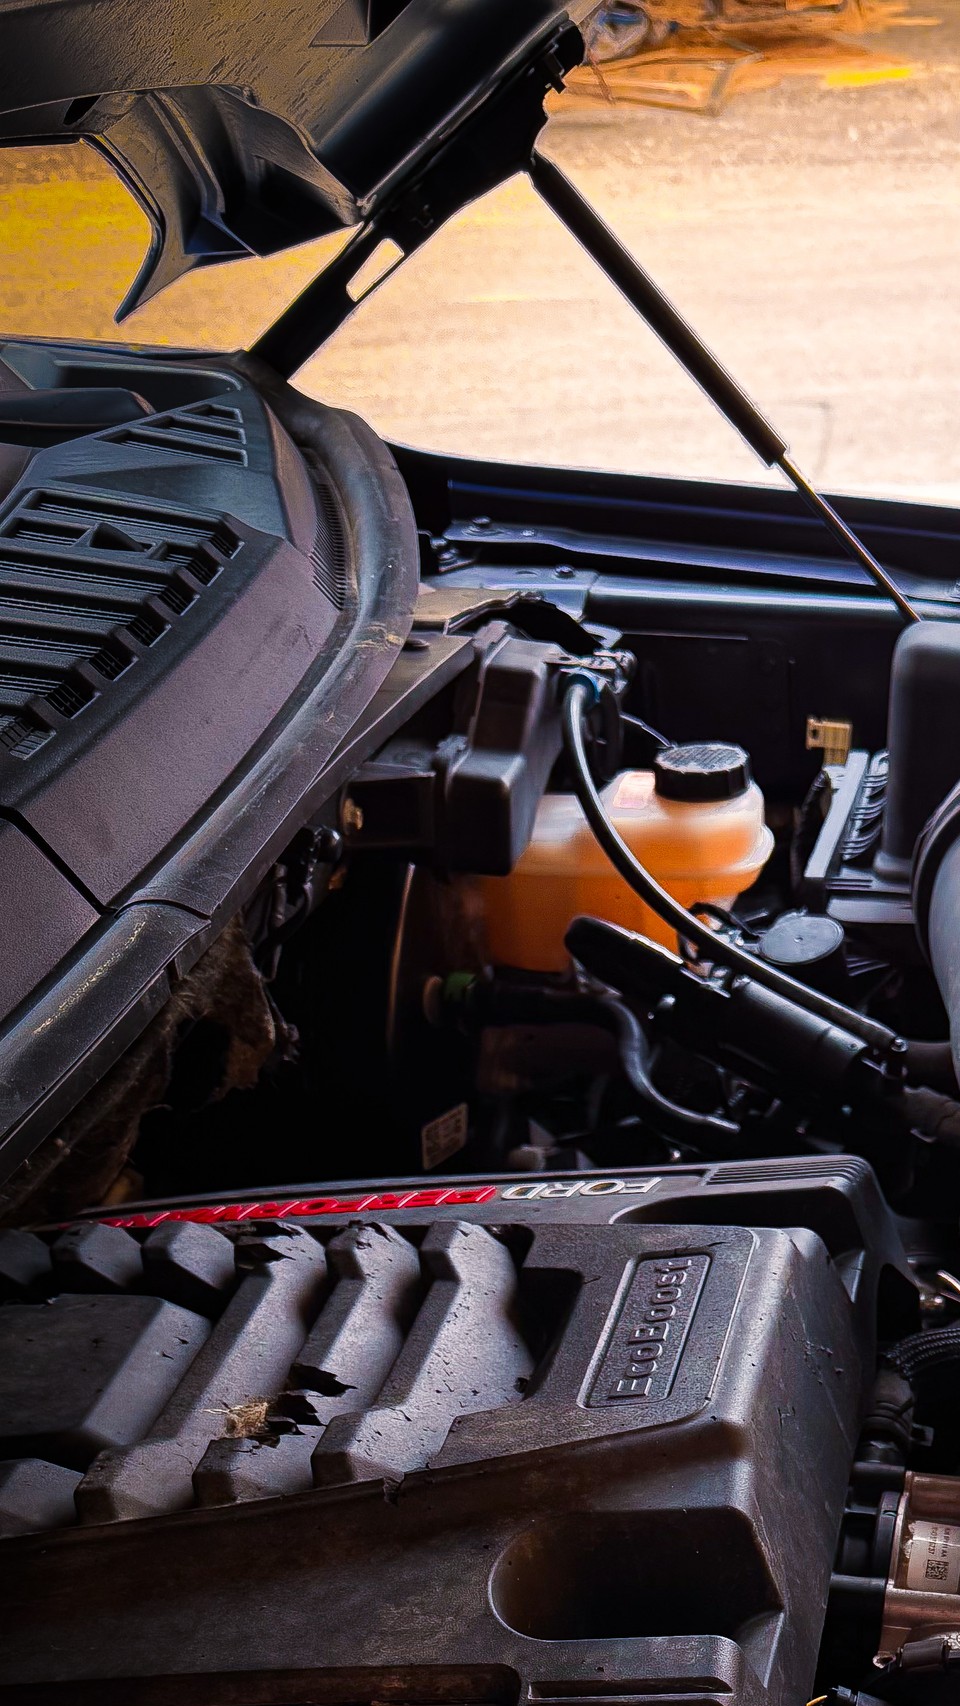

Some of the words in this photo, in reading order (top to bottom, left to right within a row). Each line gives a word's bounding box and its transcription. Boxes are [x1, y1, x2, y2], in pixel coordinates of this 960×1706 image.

[58, 1184, 496, 1230] PERFORMAN
[501, 1176, 662, 1200] FORD
[607, 1259, 692, 1399] EcoBoost
